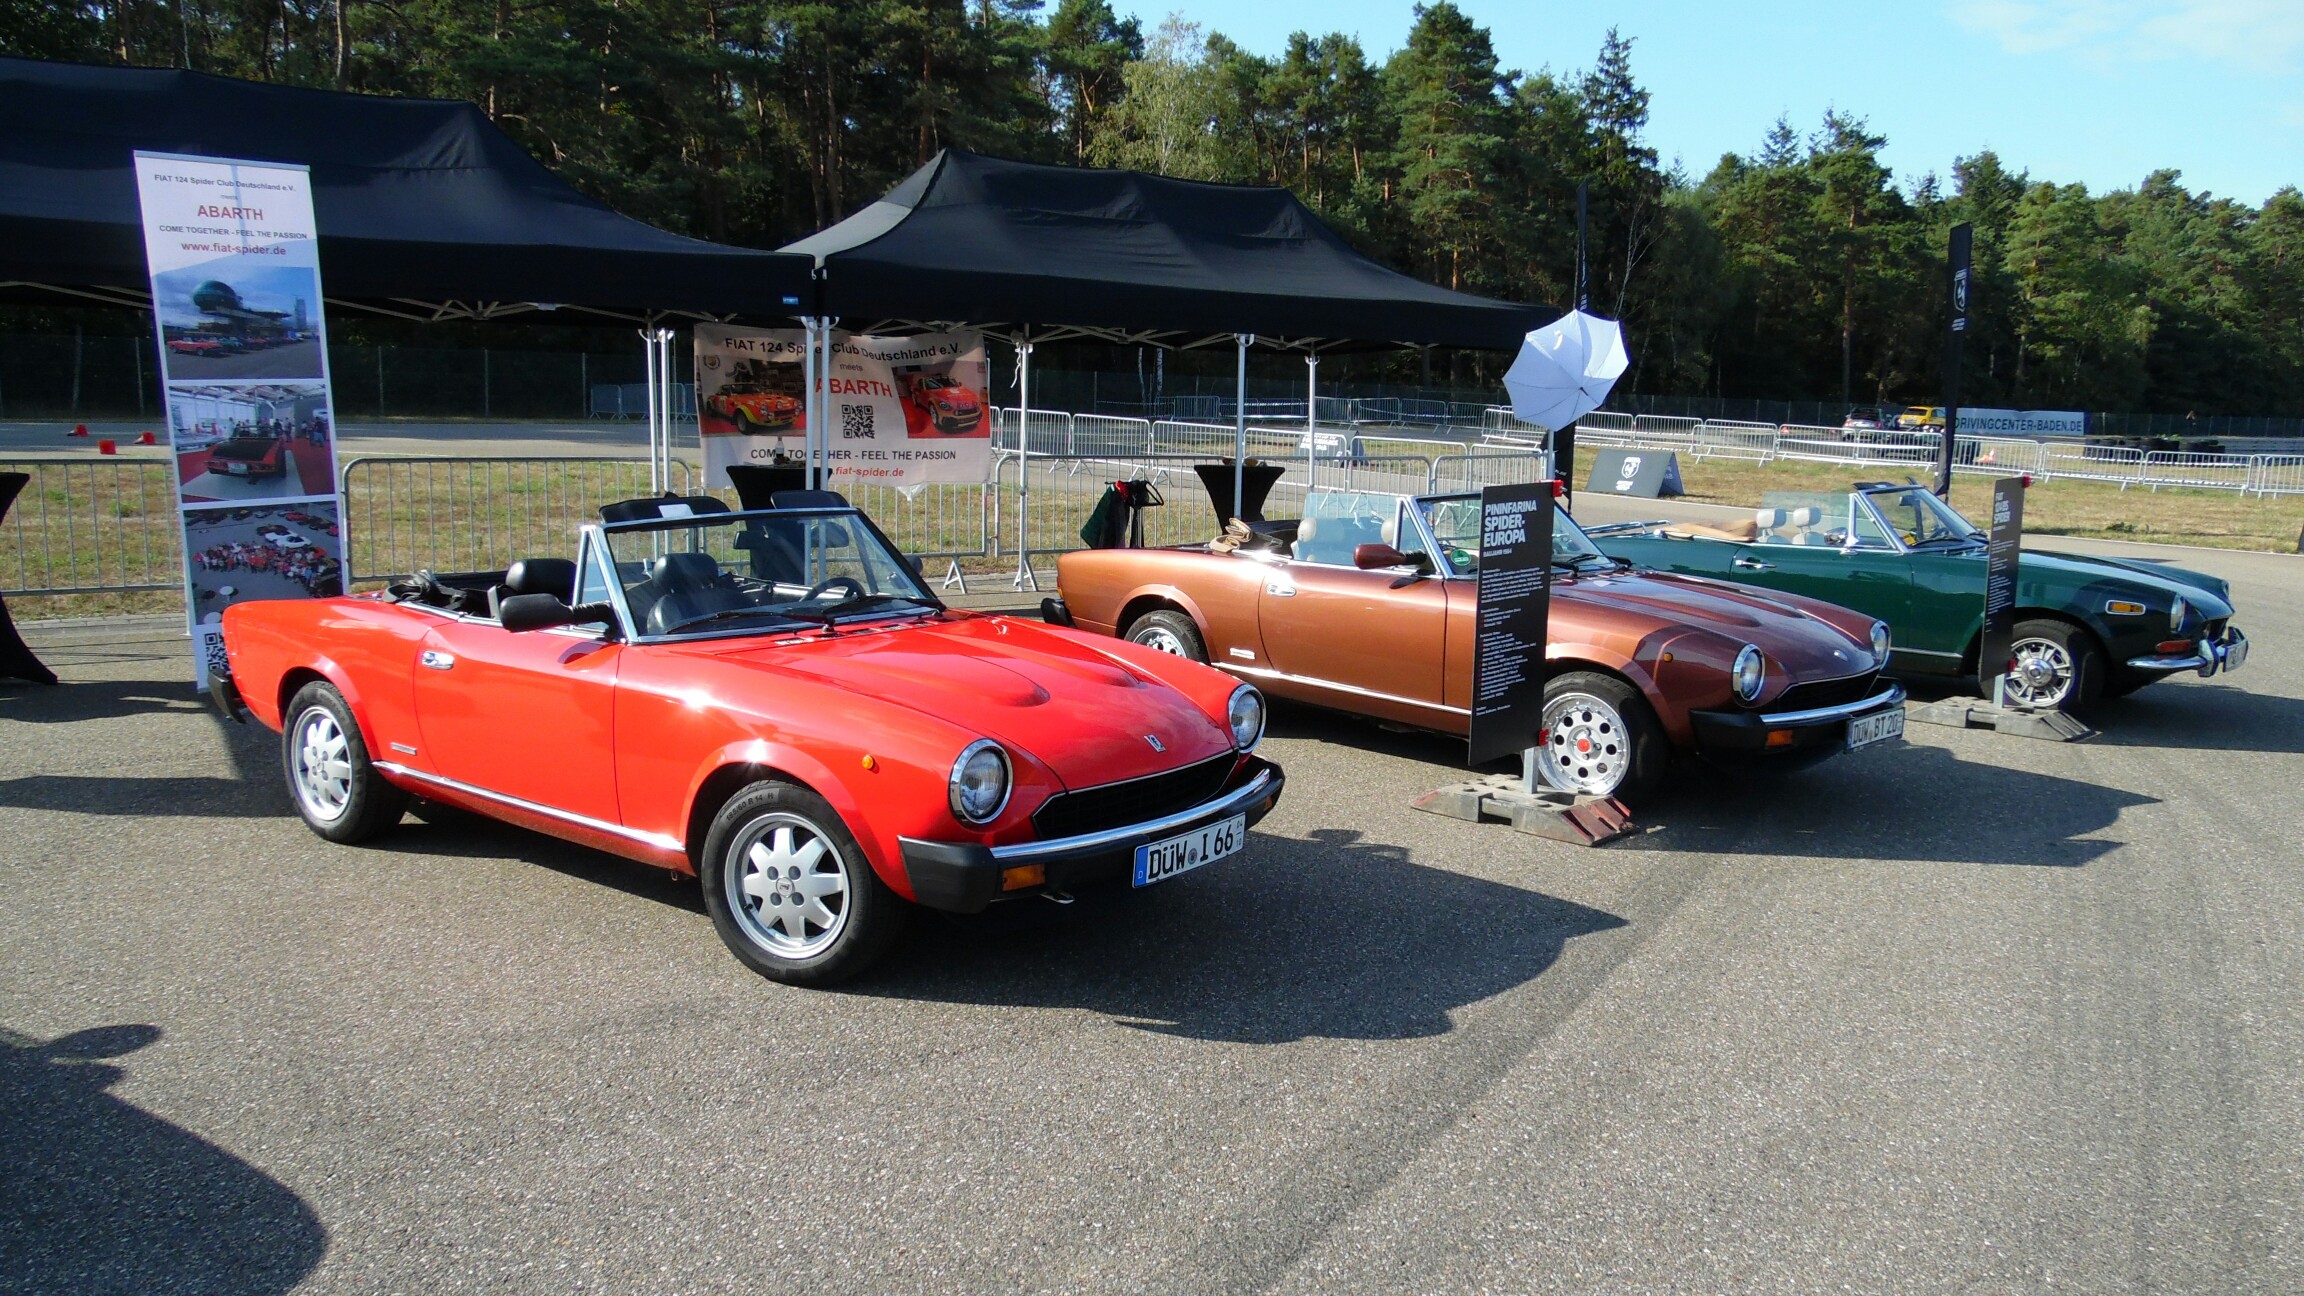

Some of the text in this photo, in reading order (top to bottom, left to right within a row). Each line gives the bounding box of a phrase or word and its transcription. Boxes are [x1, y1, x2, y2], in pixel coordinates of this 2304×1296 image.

[191, 177, 214, 185] Spider
[236, 181, 280, 190] Deutschland
[197, 204, 263, 220] ABARTH
[186, 227, 230, 235] TOGETHER
[181, 243, 286, 255] www.fiat-spider.de
[726, 338, 962, 361] FIAT 124 Spie Club Deutschland e.V.
[840, 363, 863, 371] meets
[751, 449, 776, 459] COM
[788, 450, 851, 459] TOEHER
[861, 451, 888, 460] FEEL
[892, 451, 912, 460] THE
[915, 450, 956, 460] PASSION
[1485, 500, 1537, 516] PININFARINA
[1485, 514, 1525, 532] SPIDER-
[1484, 529, 1525, 548] EUROPA
[1874, 716, 1886, 737] BT
[1138, 824, 1234, 879] D DÜW I 66
